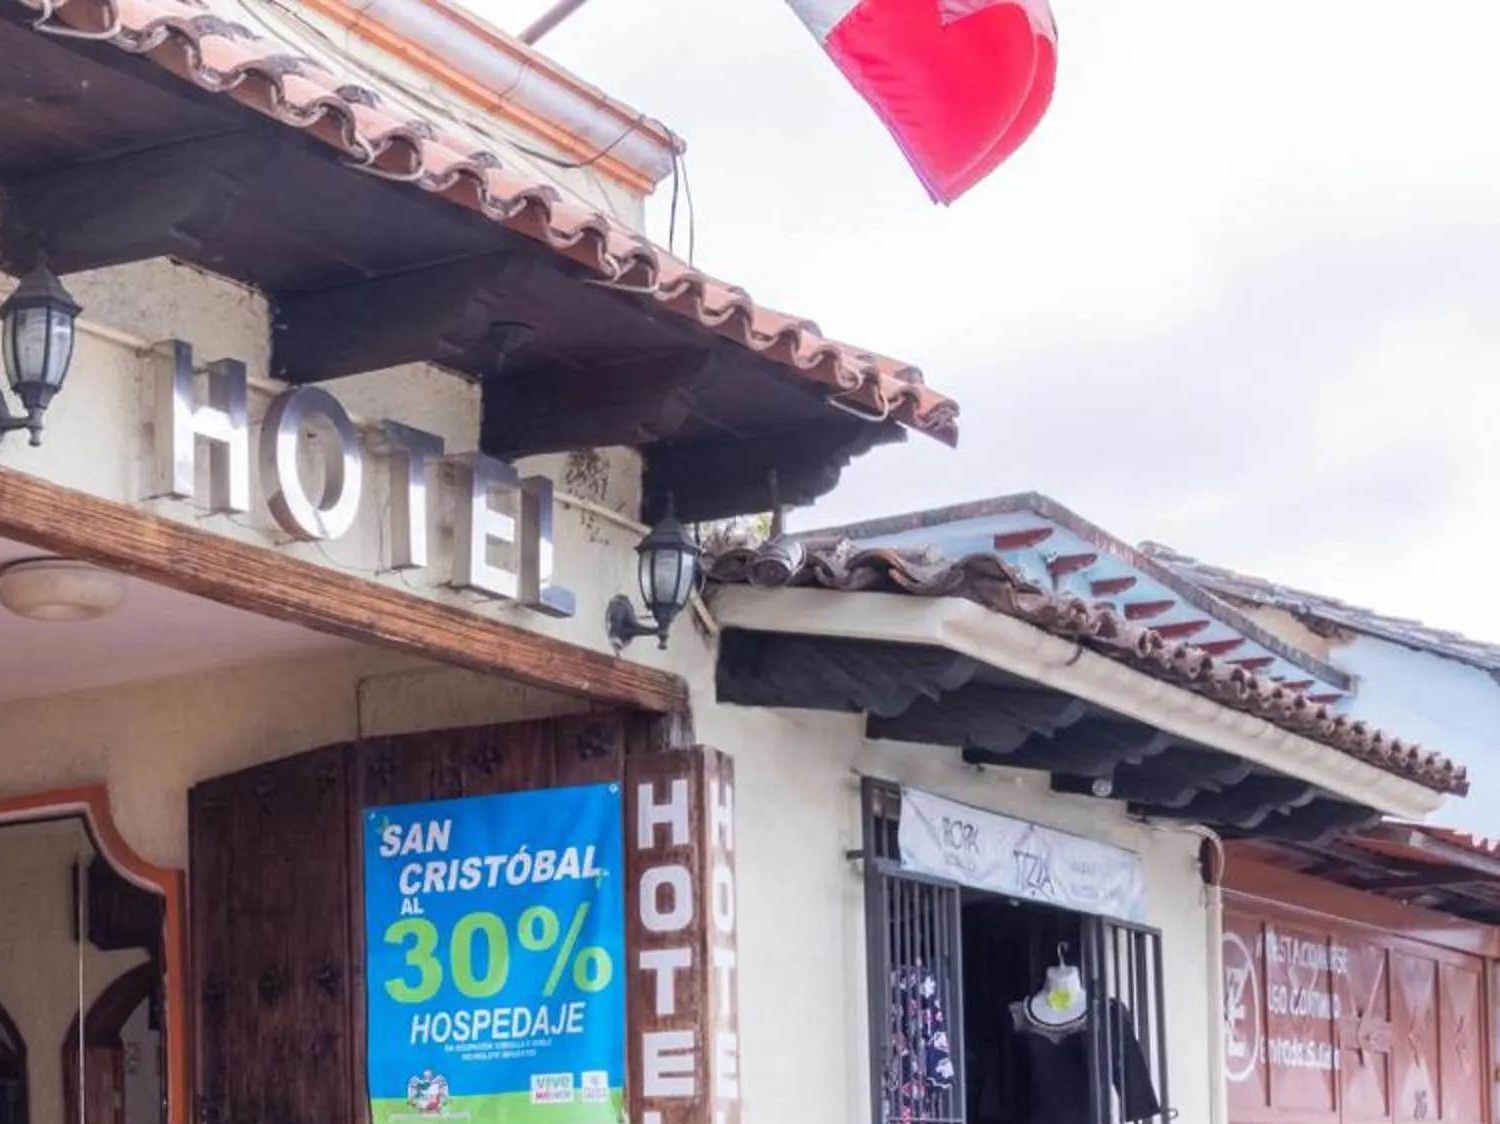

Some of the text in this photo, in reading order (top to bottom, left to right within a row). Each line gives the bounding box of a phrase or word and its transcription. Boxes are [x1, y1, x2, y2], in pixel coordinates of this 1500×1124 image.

[160, 338, 576, 619] HOTEL
[379, 818, 453, 858] SAN
[398, 843, 600, 896] CRISTÓBAL
[400, 896, 425, 915] AL
[382, 901, 614, 1005] 30%
[409, 1001, 587, 1045] HOSPEDAJE
